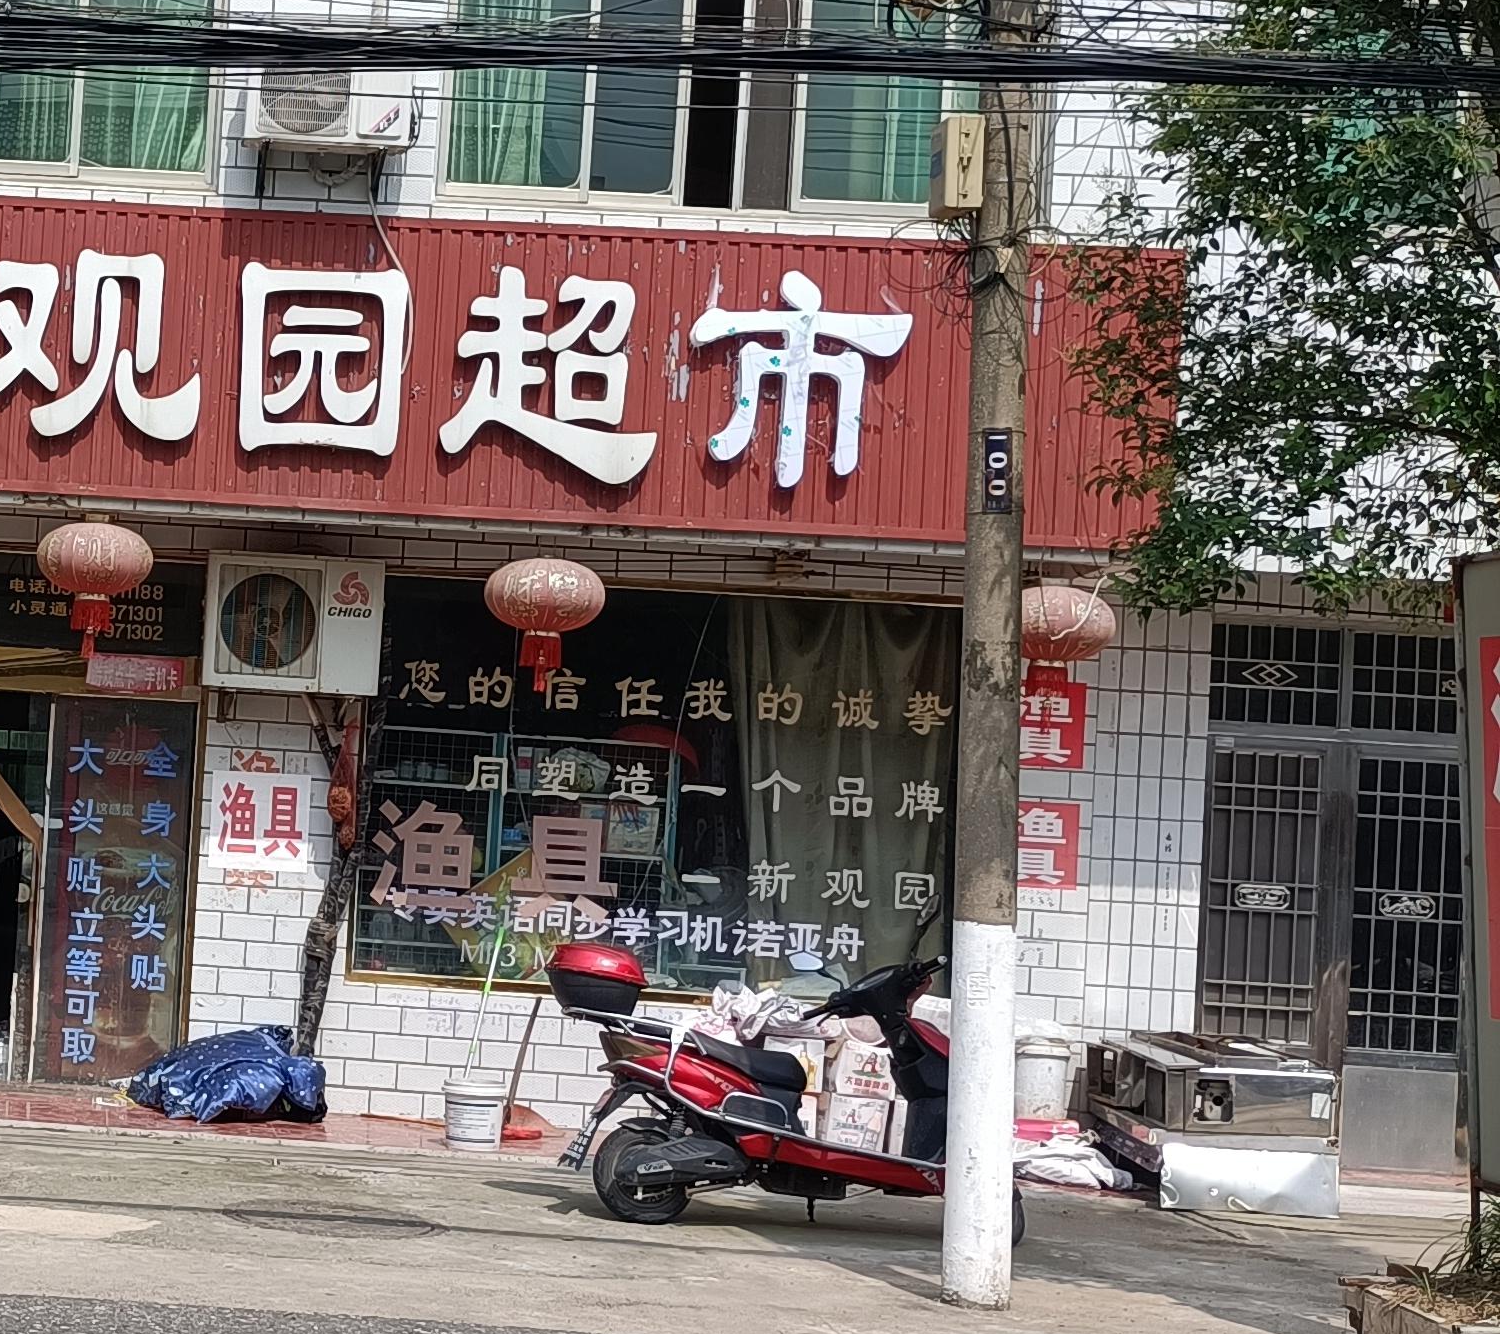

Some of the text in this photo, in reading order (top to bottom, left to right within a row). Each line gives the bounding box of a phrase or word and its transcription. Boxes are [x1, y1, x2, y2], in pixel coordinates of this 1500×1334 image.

[327, 605, 372, 619] CHIGO
[400, 659, 953, 736] 您的信任我的诚挚
[218, 782, 303, 859] 渔具
[465, 754, 944, 823] 同塑造一个品牌
[60, 738, 104, 1063] 大头贴立等可取
[131, 741, 179, 992] 全身大头贴
[370, 799, 618, 929] 渔具
